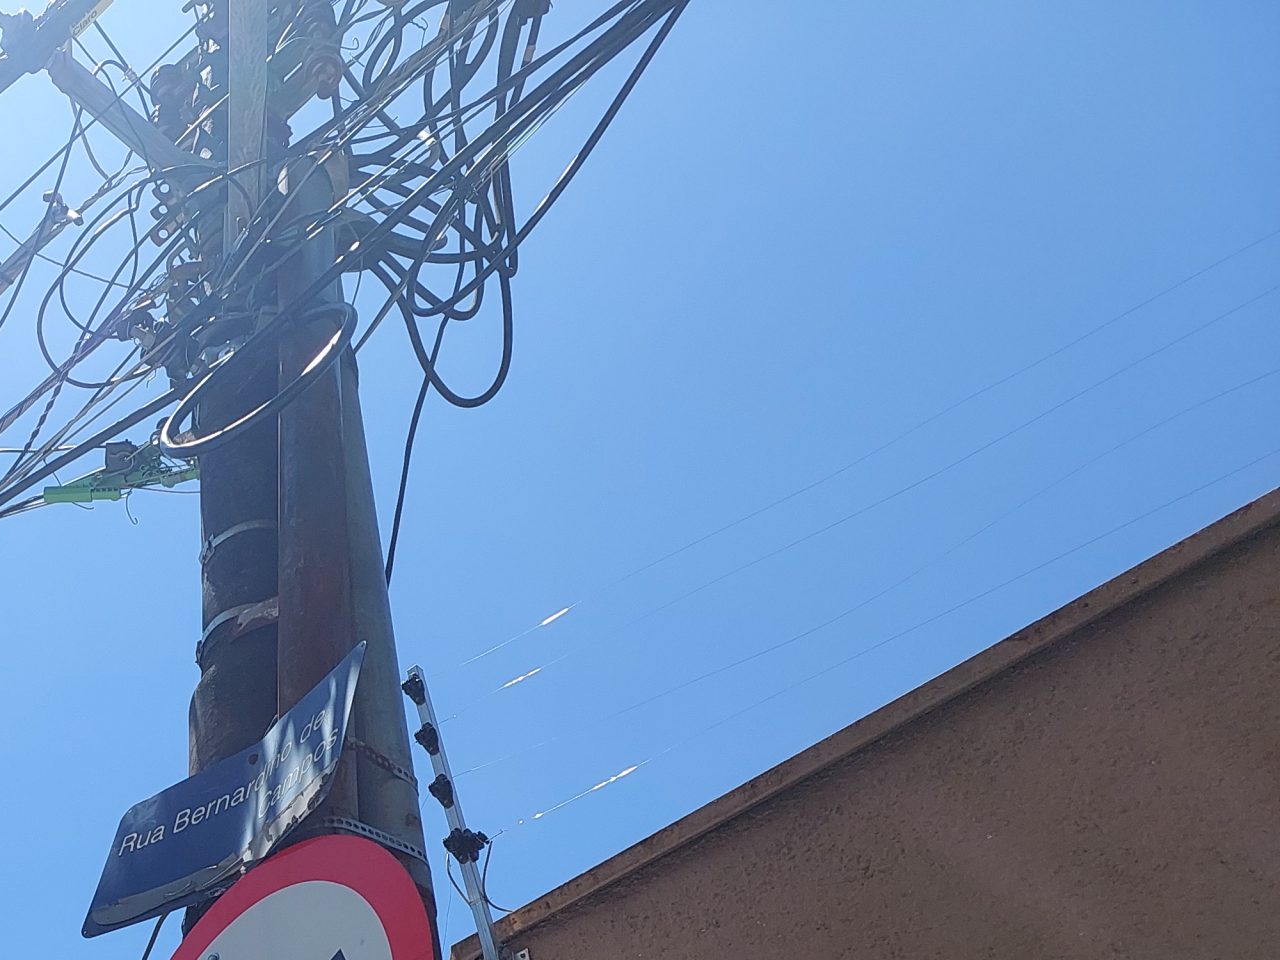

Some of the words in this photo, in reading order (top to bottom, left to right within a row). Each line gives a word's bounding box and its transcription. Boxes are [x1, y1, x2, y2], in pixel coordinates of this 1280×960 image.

[72, 10, 98, 36] Claro
[118, 824, 165, 857] Rua
[172, 741, 293, 835] Bernardino
[299, 709, 326, 744] de
